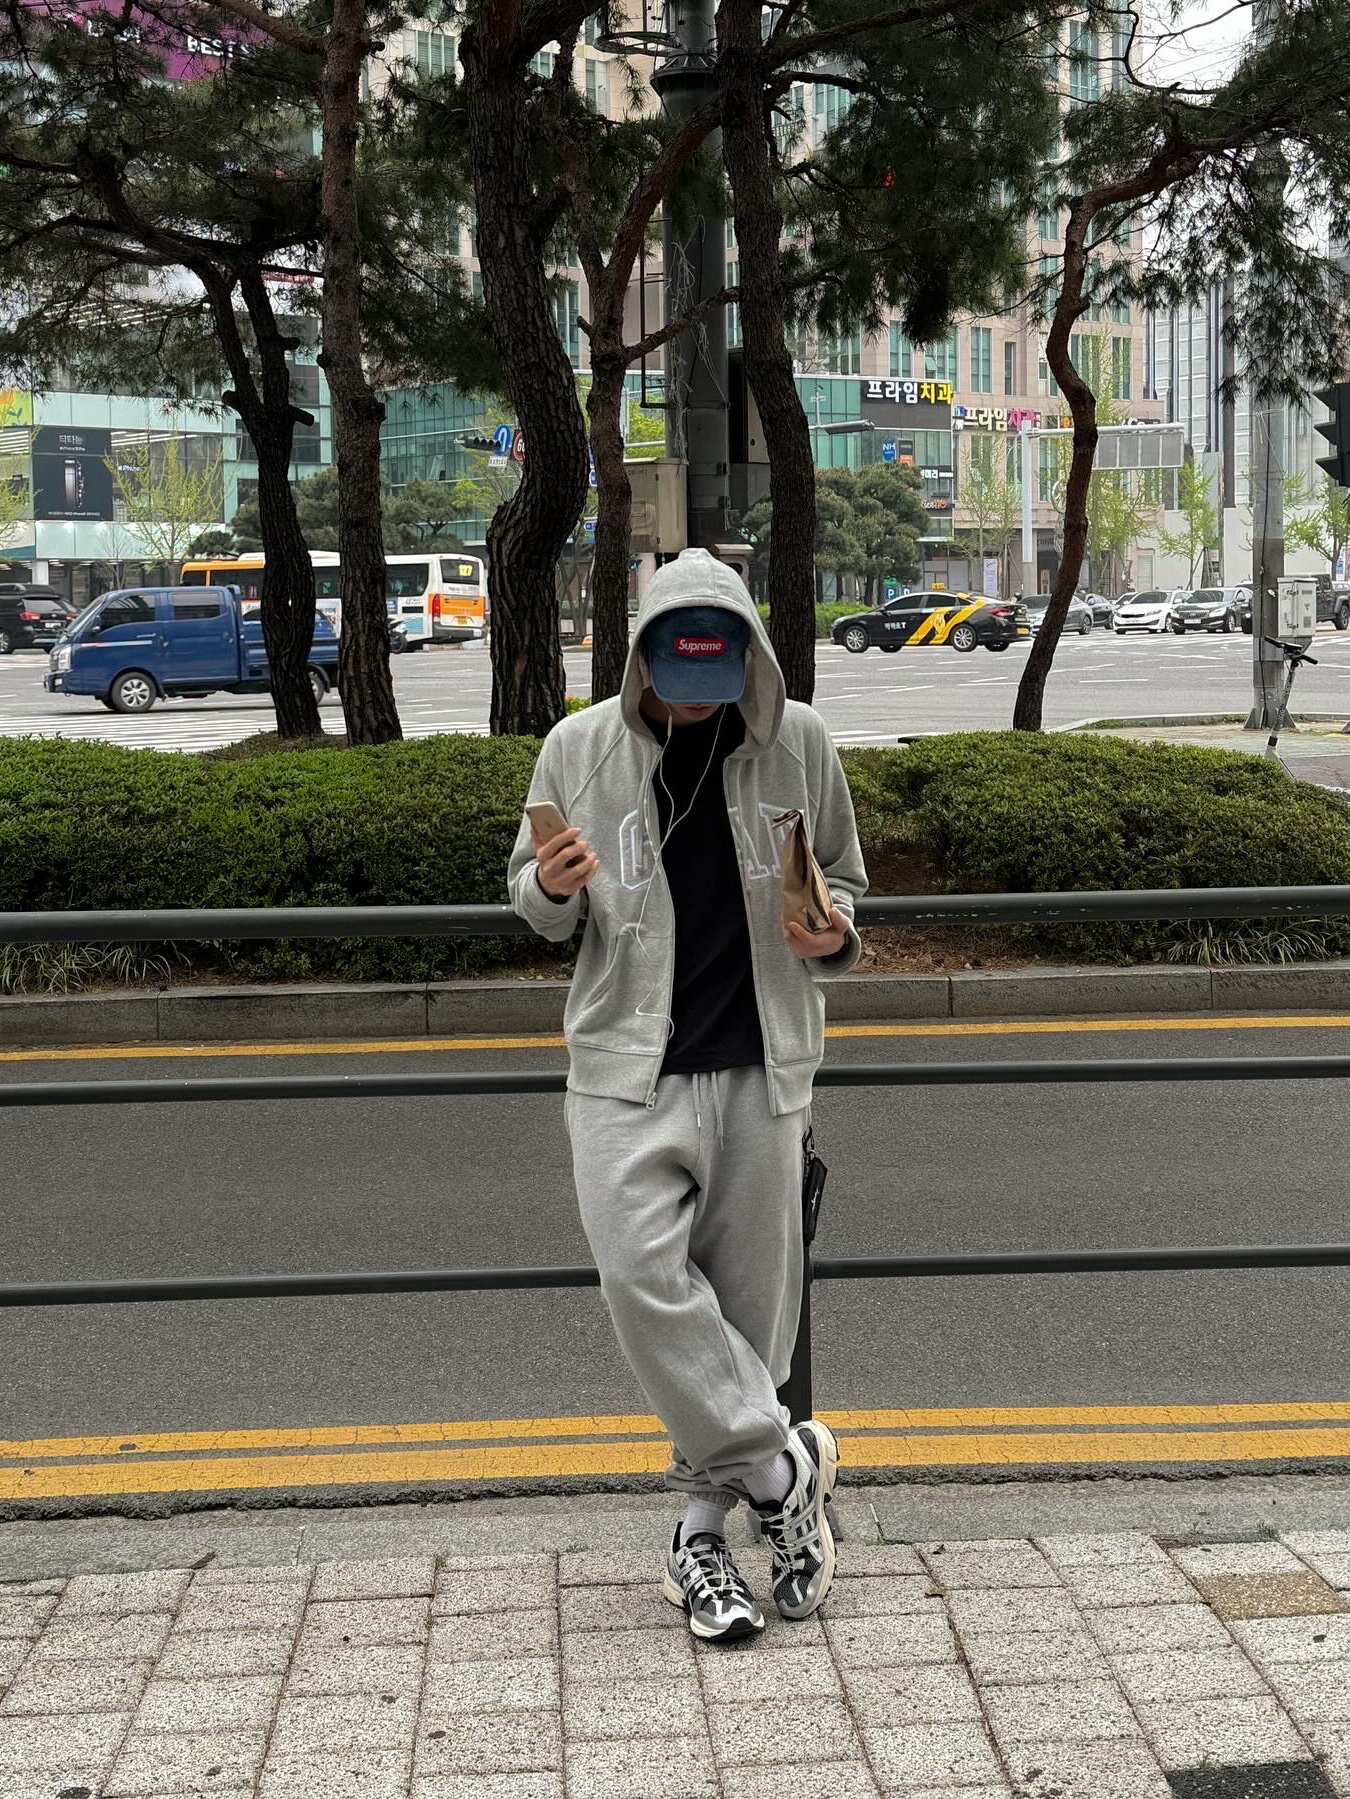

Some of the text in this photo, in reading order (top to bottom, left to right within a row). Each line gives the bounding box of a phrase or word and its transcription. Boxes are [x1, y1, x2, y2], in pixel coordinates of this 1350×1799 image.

[867, 380, 954, 404] 프라임치과
[882, 442, 896, 451] NH
[887, 588, 895, 599] P
[678, 639, 723, 654] Supreme
